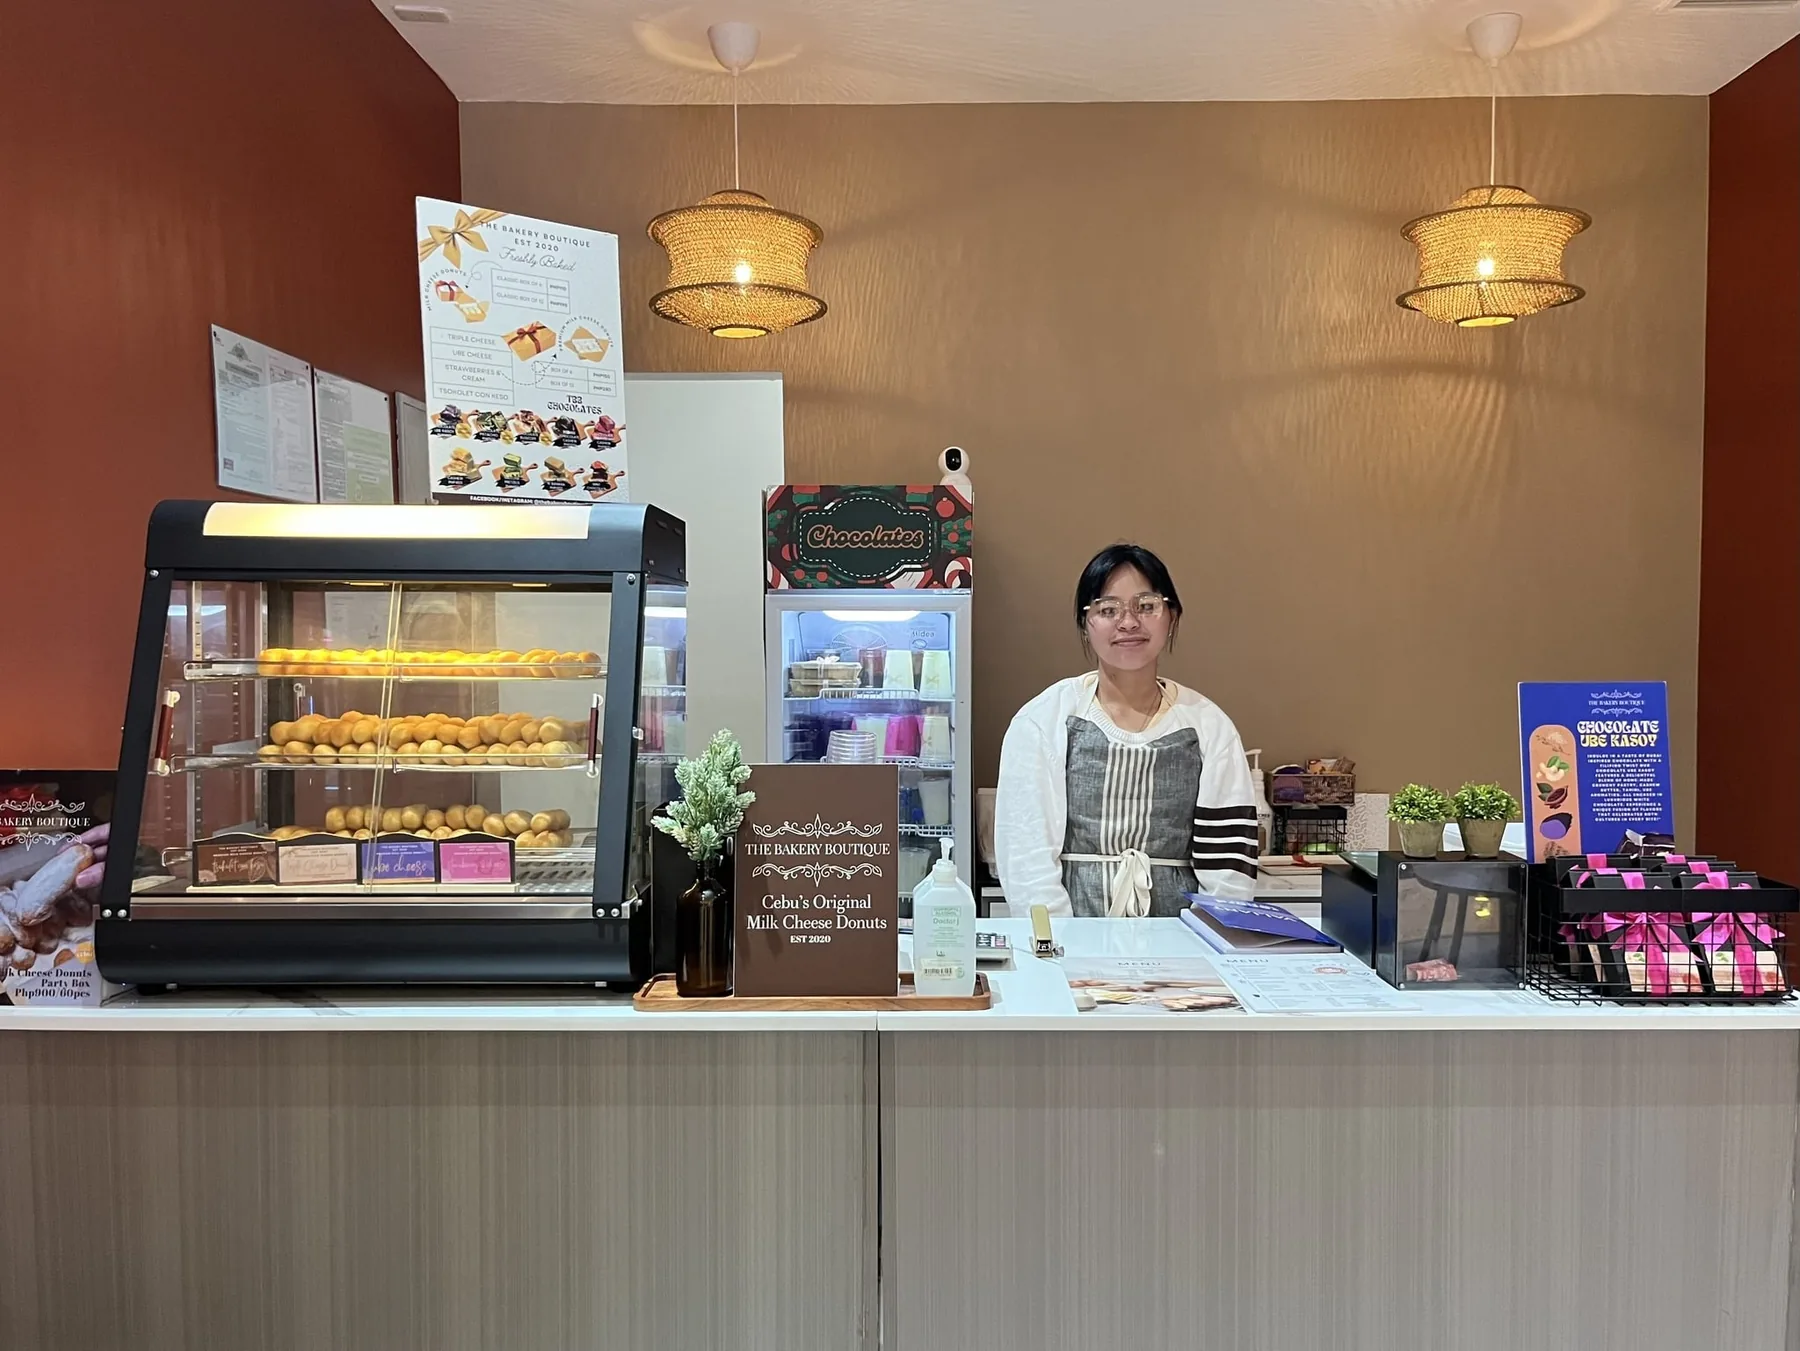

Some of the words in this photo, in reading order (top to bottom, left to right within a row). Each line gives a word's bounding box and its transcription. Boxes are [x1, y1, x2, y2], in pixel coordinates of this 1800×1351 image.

[502, 225, 539, 238] BAKERY
[543, 233, 590, 248] BOUTIQUE
[514, 238, 531, 247] EST
[535, 242, 559, 252] 2020
[498, 246, 537, 268] Freshly
[540, 254, 576, 272] Baked
[448, 334, 469, 342] TRIPLE
[470, 336, 496, 345] CHEESE
[467, 352, 492, 360] CHEESE
[547, 401, 602, 414] CHOCOLATES
[807, 524, 924, 549] Chocolates
[1577, 721, 1659, 734] CHOCOLATE
[1580, 735, 1607, 747] UBE
[1610, 734, 1658, 747] KASOY
[36, 817, 91, 828] BOUTIQUE
[745, 843, 772, 855] THE
[774, 843, 822, 855] BAKERY
[825, 843, 890, 857] BOUTIQUE
[762, 894, 810, 909] Cebu's
[813, 894, 872, 914] Original
[746, 915, 779, 929] Milk
[782, 915, 832, 929] Cheese
[836, 915, 888, 929] Donuts
[790, 935, 807, 943] EST
[808, 935, 831, 943] 2020
[18, 969, 53, 977] Cheese
[56, 969, 92, 977] Donuts
[41, 979, 68, 988] Party
[72, 979, 90, 987] Box
[15, 987, 90, 1000] Php900/60pcs
